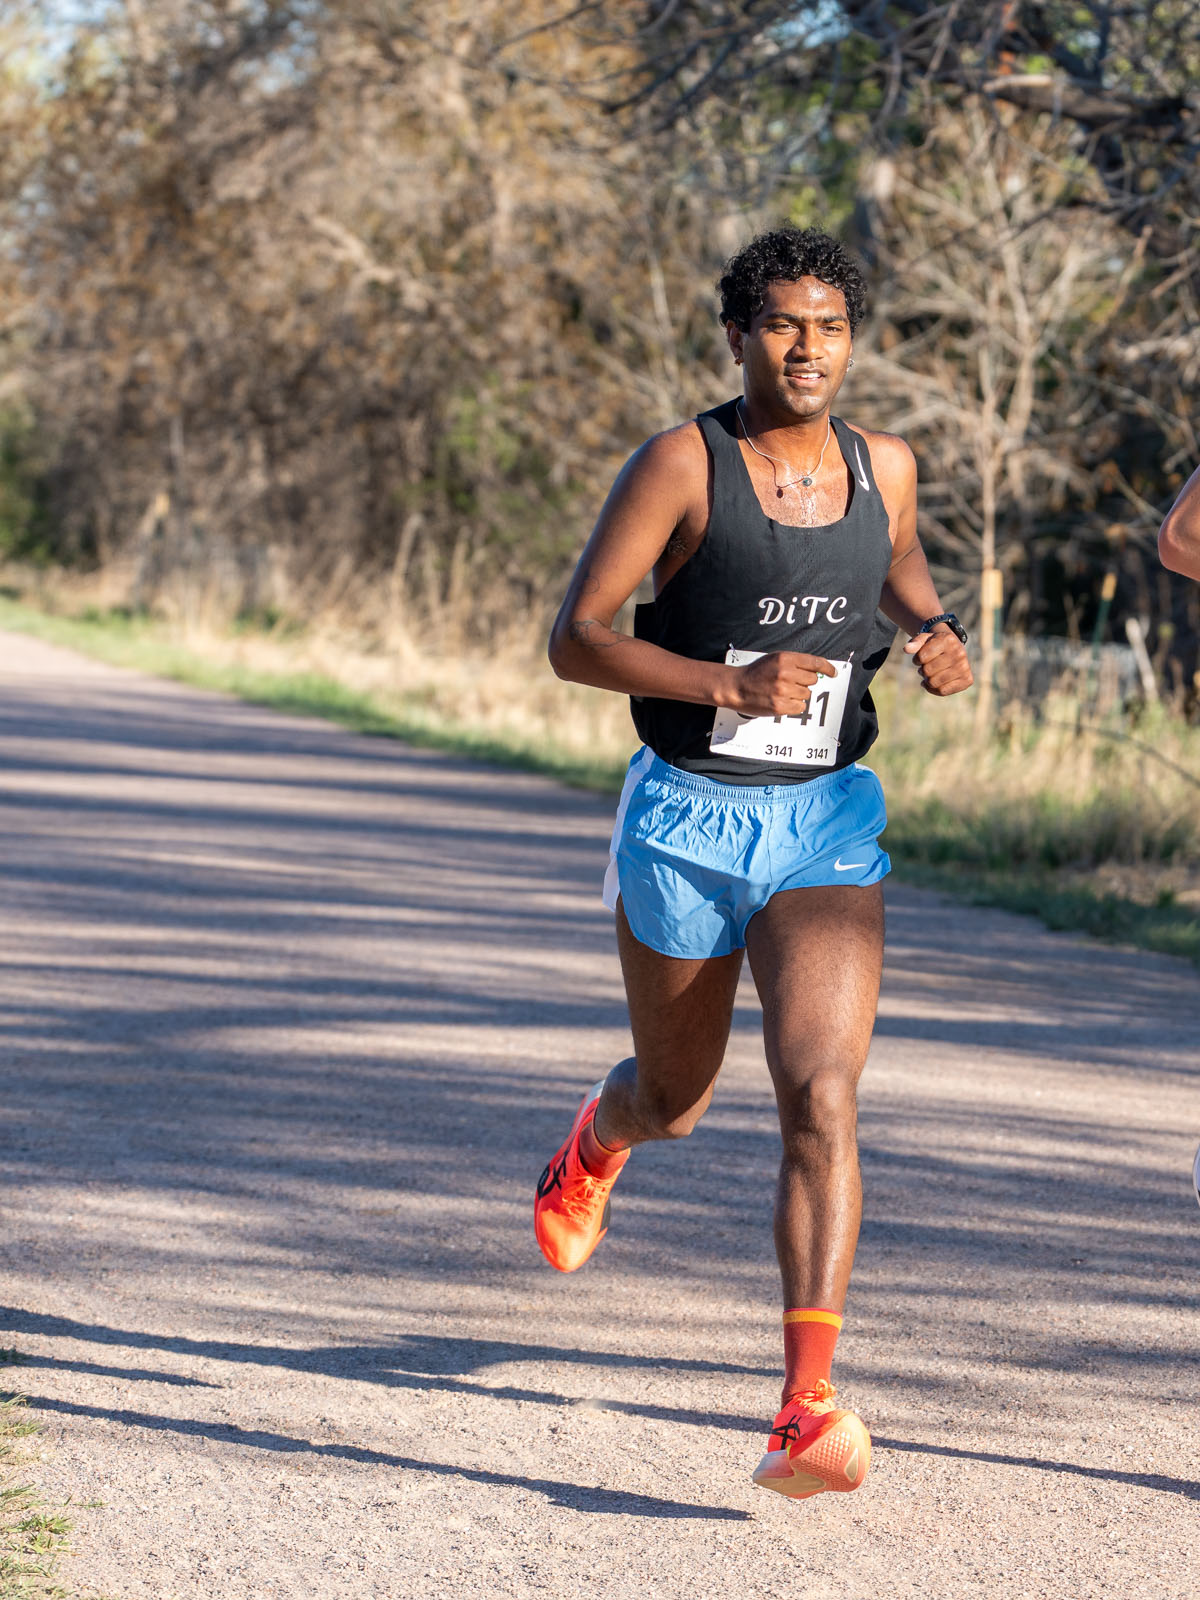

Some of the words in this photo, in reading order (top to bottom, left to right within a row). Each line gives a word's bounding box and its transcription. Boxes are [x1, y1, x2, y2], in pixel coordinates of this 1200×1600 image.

[758, 596, 848, 625] DiTC
[764, 744, 793, 758] 3141
[806, 747, 829, 760] 3141
